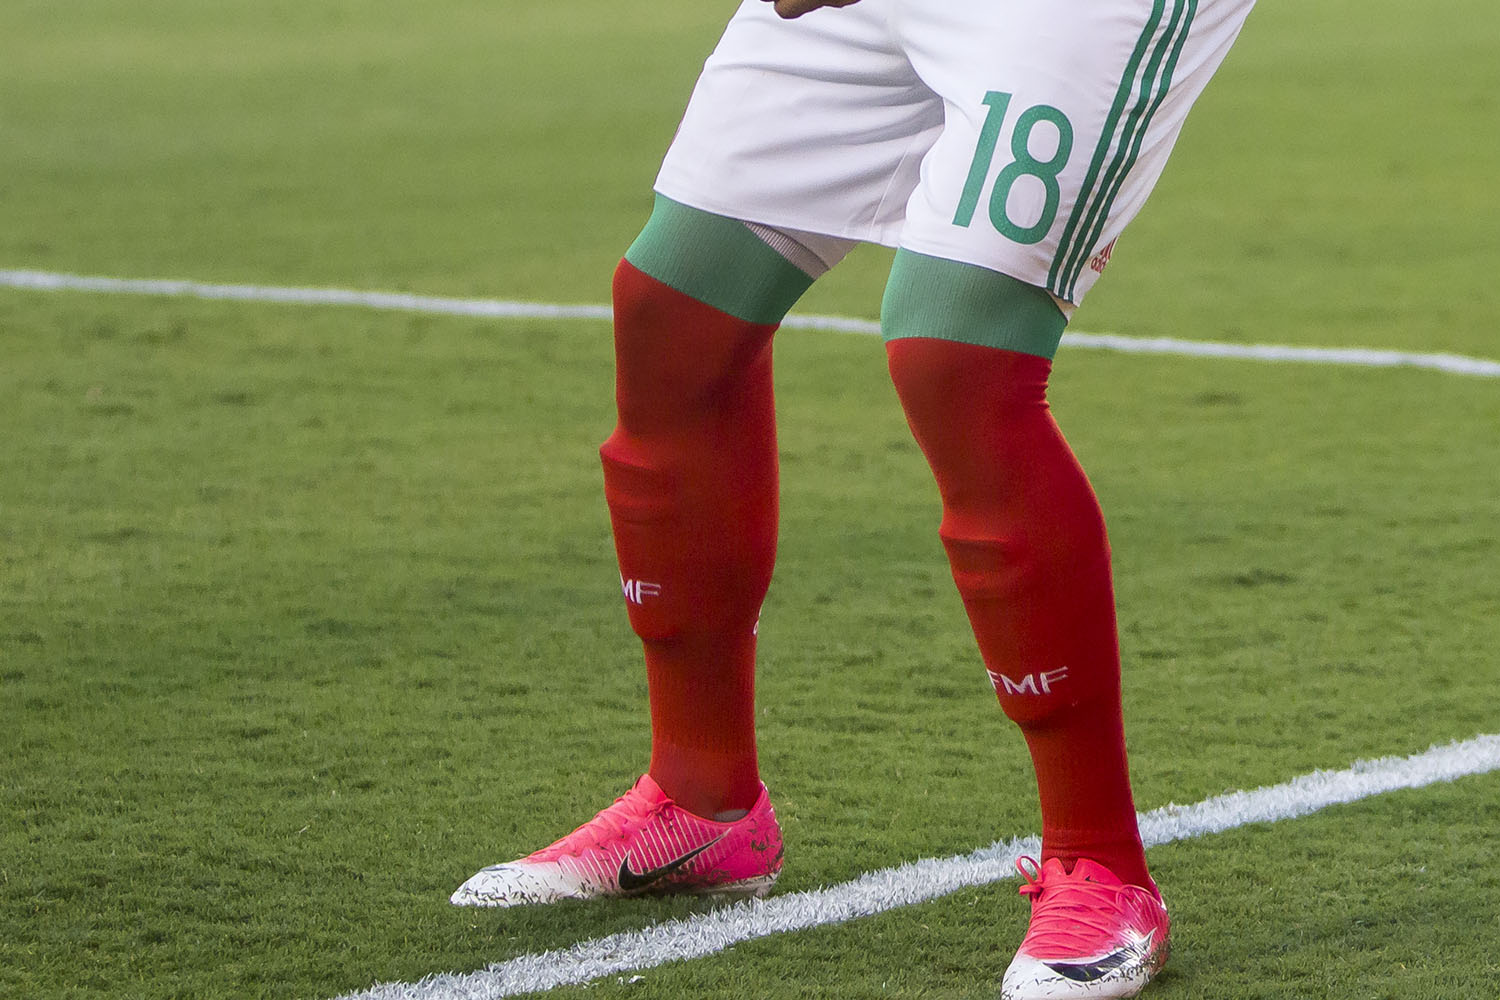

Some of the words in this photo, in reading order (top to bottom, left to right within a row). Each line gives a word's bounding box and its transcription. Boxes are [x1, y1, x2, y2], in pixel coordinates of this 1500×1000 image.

[952, 90, 1074, 245] 18
[620, 572, 661, 605] MF
[986, 666, 1068, 695] FMF
